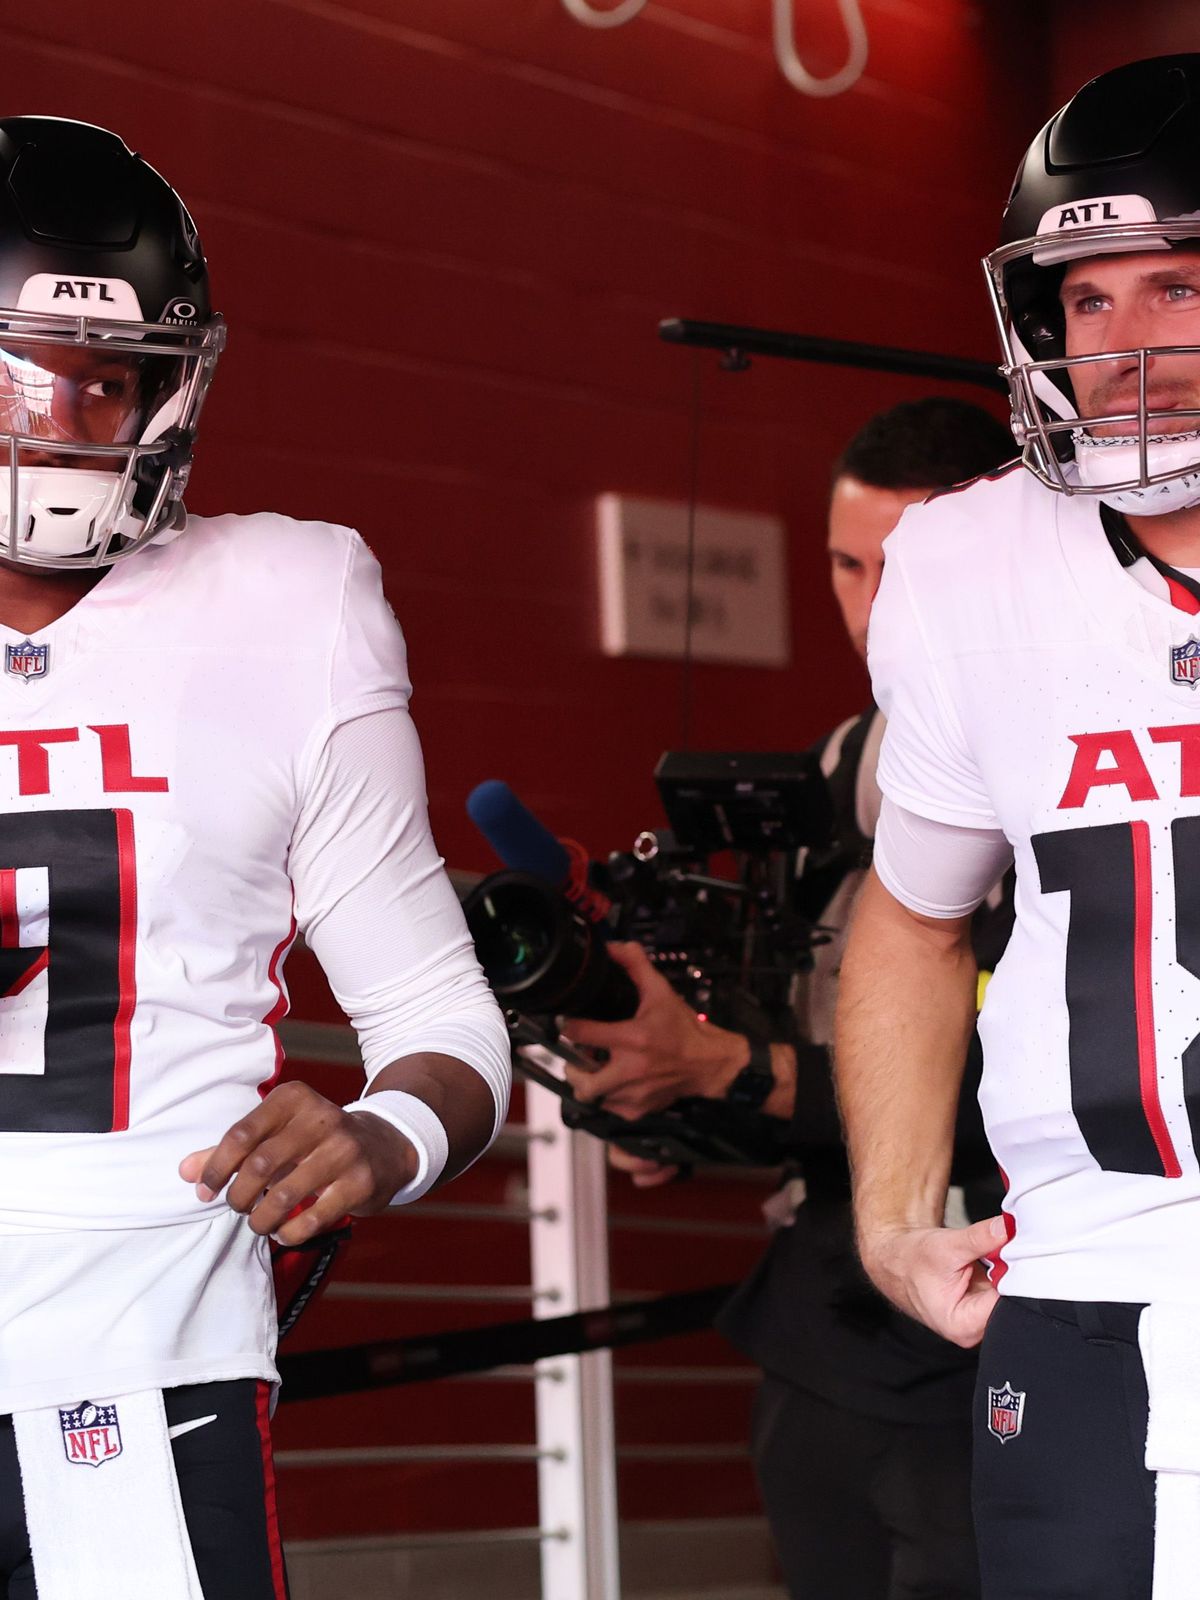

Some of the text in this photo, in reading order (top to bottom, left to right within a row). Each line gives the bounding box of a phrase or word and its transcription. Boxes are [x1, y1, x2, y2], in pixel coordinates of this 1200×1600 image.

[1058, 202, 1119, 229] ATL
[52, 280, 115, 302] ATL
[11, 656, 43, 674] NFL
[1175, 656, 1200, 679] NF
[993, 1409, 1016, 1433] NFL
[67, 1426, 118, 1461] NFL
